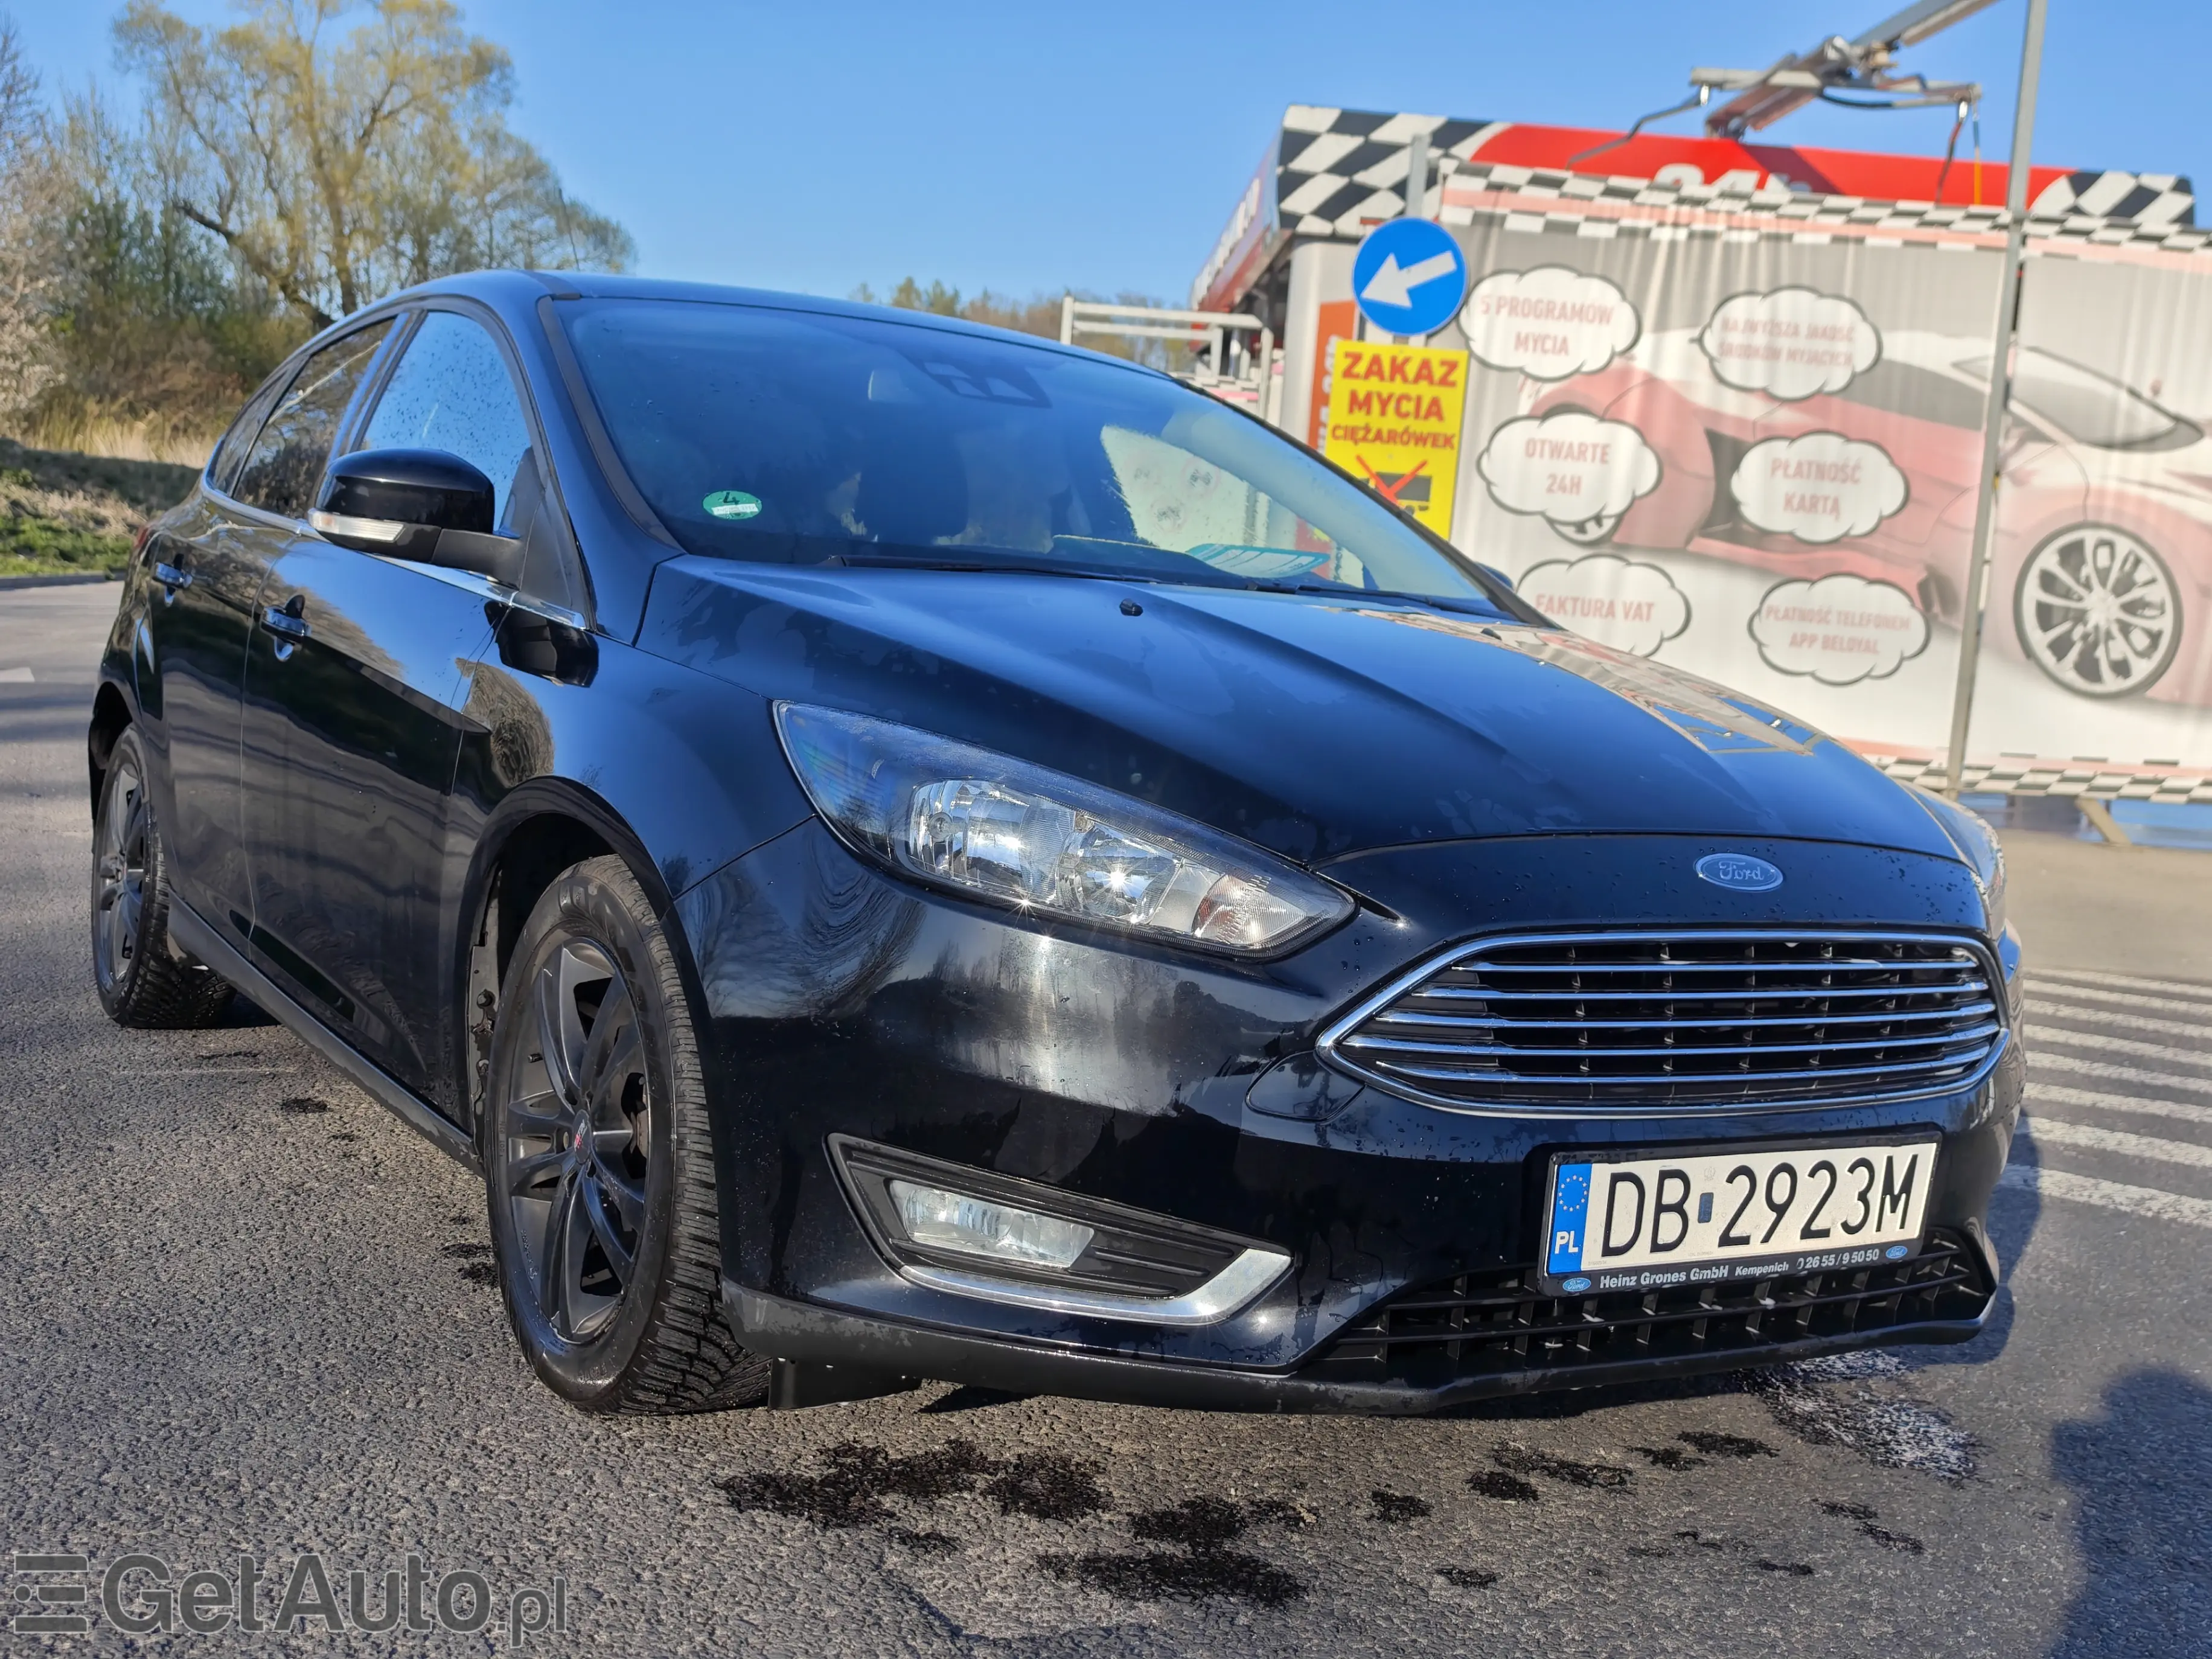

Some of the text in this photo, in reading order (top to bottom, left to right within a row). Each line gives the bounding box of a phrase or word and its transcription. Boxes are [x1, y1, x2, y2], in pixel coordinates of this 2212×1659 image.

[1481, 295, 1491, 313] 5
[1514, 332, 1569, 356] MYCIA
[1341, 351, 1459, 388] ZAKAZ
[1348, 389, 1445, 422] MYCIA
[1331, 424, 1456, 450] CIĘŻARÓWEK
[1524, 437, 1611, 464] OTWARTE
[1770, 456, 1863, 484] PŁATNOŚĆ
[1546, 473, 1582, 496] 24H
[1783, 492, 1840, 522] KARTĄ
[1535, 593, 1655, 622] FAKTURA VAT
[1789, 632, 1819, 648] APP
[1718, 860, 1765, 880] Ford
[1555, 1153, 1919, 1258] PL DB 2923M
[1599, 1275, 1637, 1289] Heinz
[1640, 1271, 1686, 1285] Grones
[1690, 1265, 1728, 1281] GmbH
[1734, 1261, 1789, 1278] Kempenich
